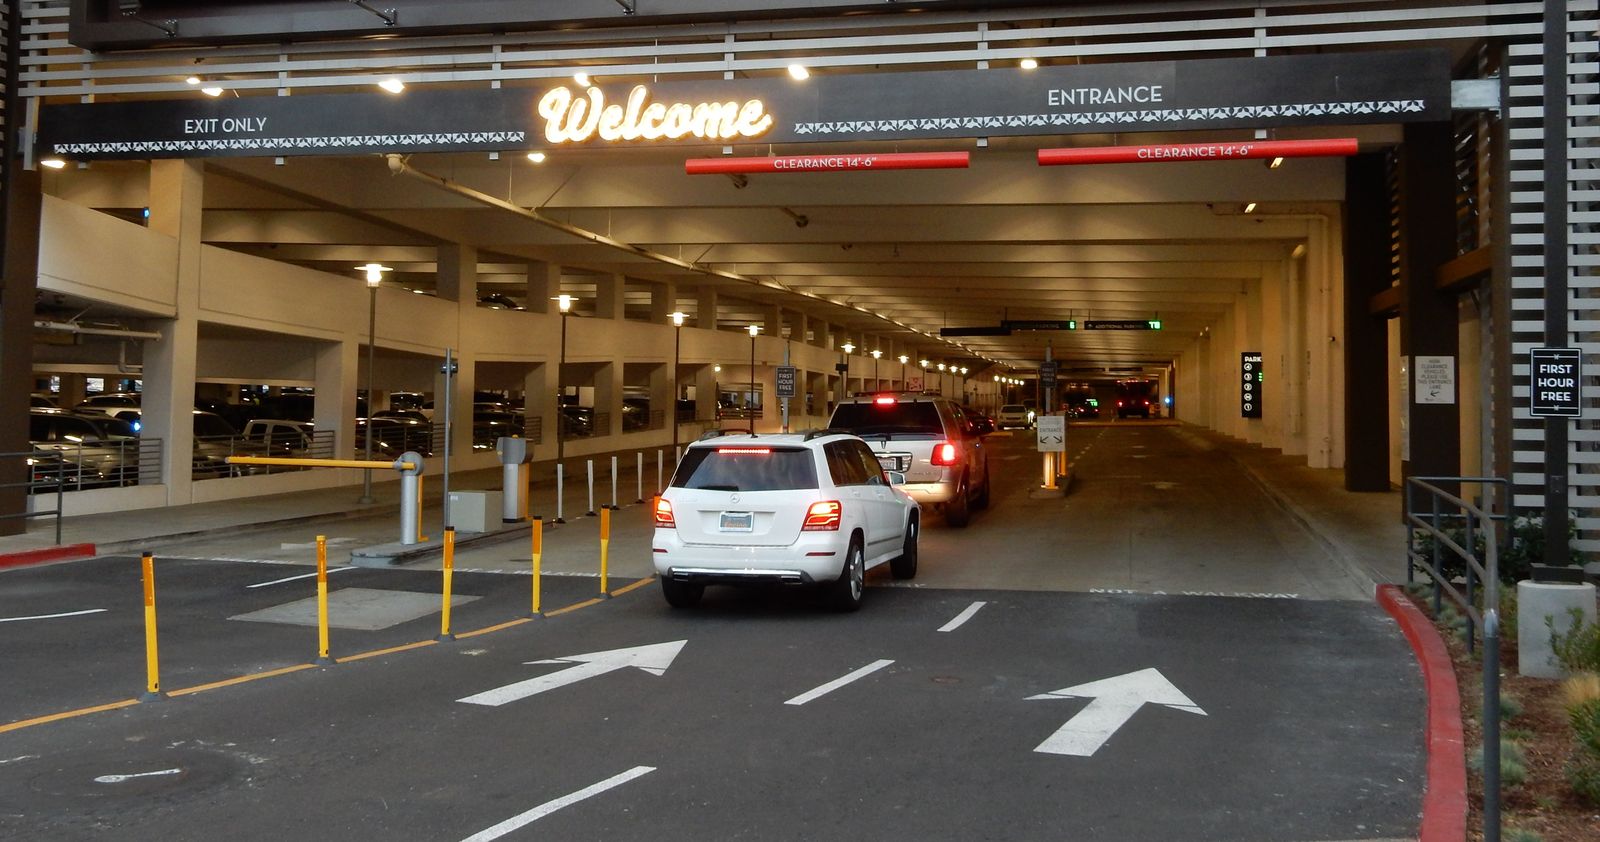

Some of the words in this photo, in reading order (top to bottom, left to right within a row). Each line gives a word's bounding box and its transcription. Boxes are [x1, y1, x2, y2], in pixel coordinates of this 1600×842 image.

[1048, 85, 1163, 106] ENTRANCE
[537, 84, 773, 144] Welcome
[184, 118, 219, 134] EXIT
[222, 117, 267, 133] ONLY
[1137, 146, 1216, 159] CLEARANCE
[774, 157, 844, 169] CLEARANCE
[1539, 364, 1573, 374] FIRST
[1538, 378, 1574, 388] HOUR
[1540, 391, 1571, 401] FREE
